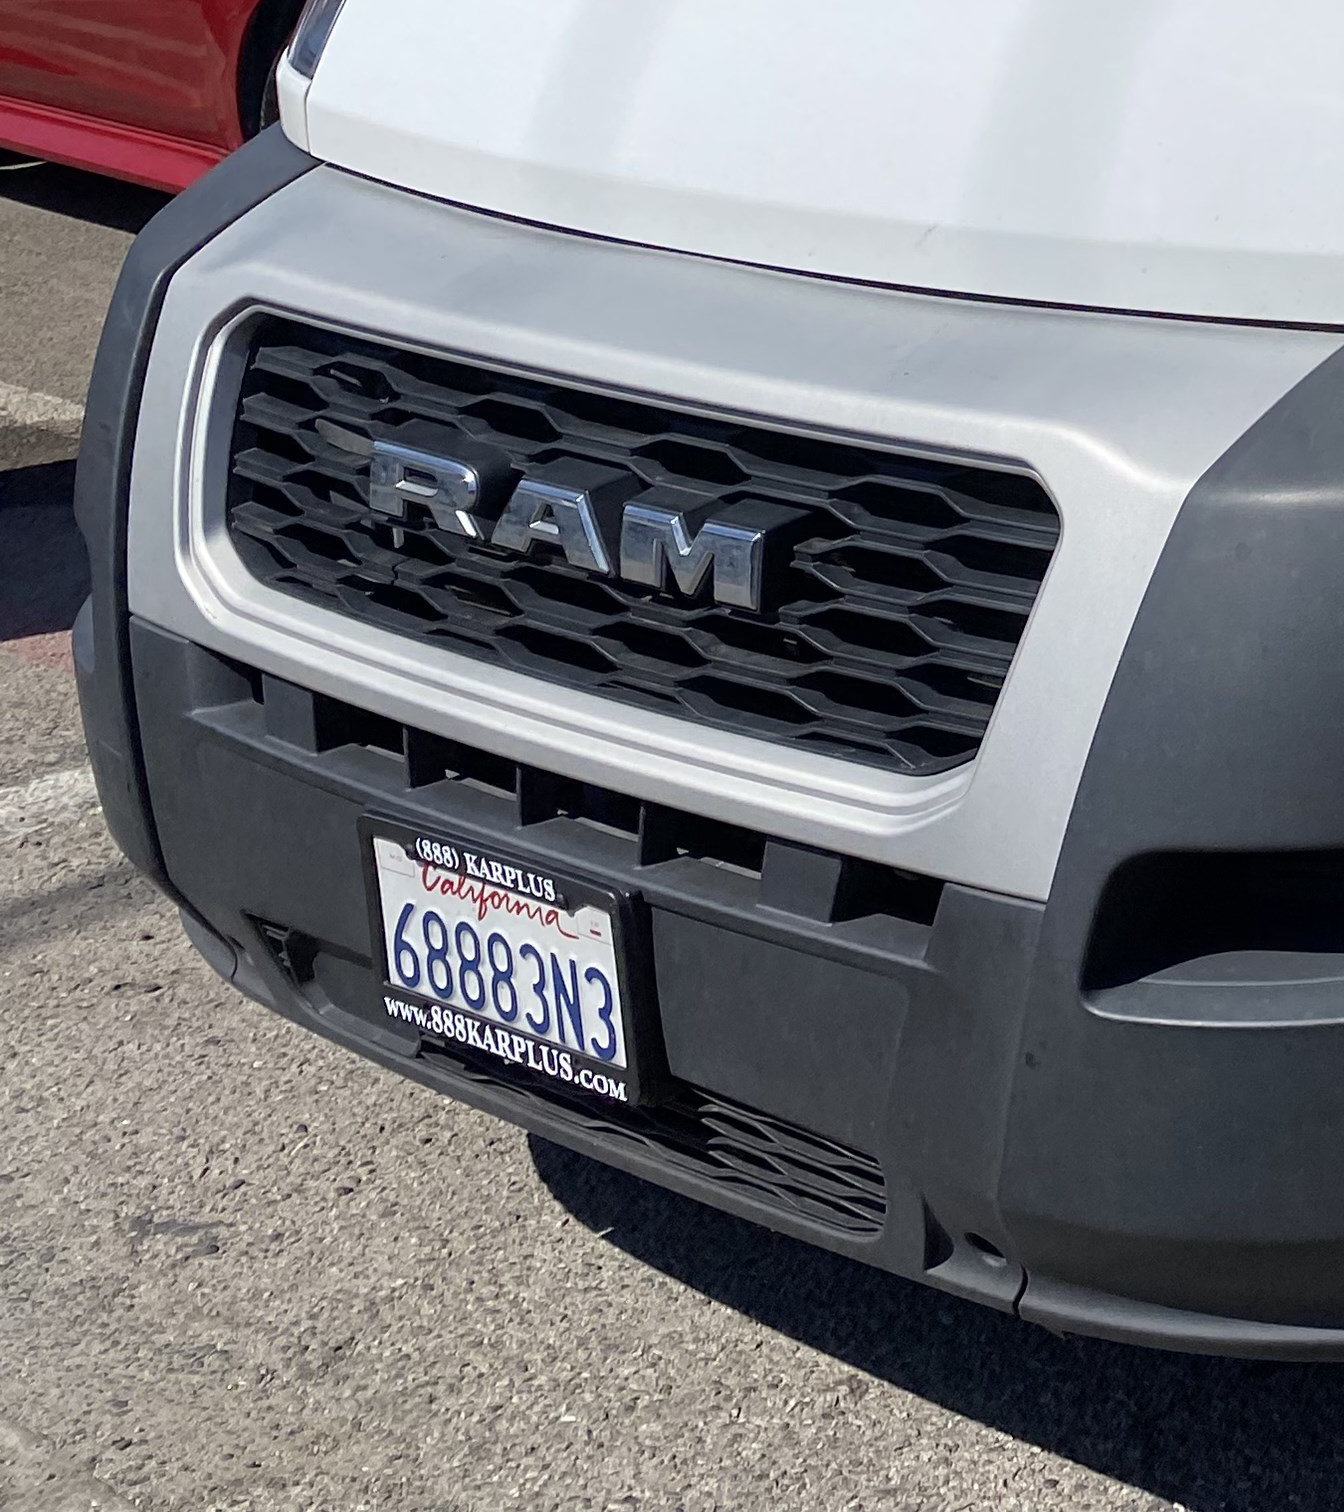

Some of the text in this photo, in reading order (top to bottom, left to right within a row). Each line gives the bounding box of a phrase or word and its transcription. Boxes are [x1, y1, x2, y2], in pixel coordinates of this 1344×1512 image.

[369, 440, 765, 614] RAM
[414, 837, 556, 902] (888) KARPLUS
[420, 861, 580, 940] California
[394, 902, 618, 1063] 68883N3
